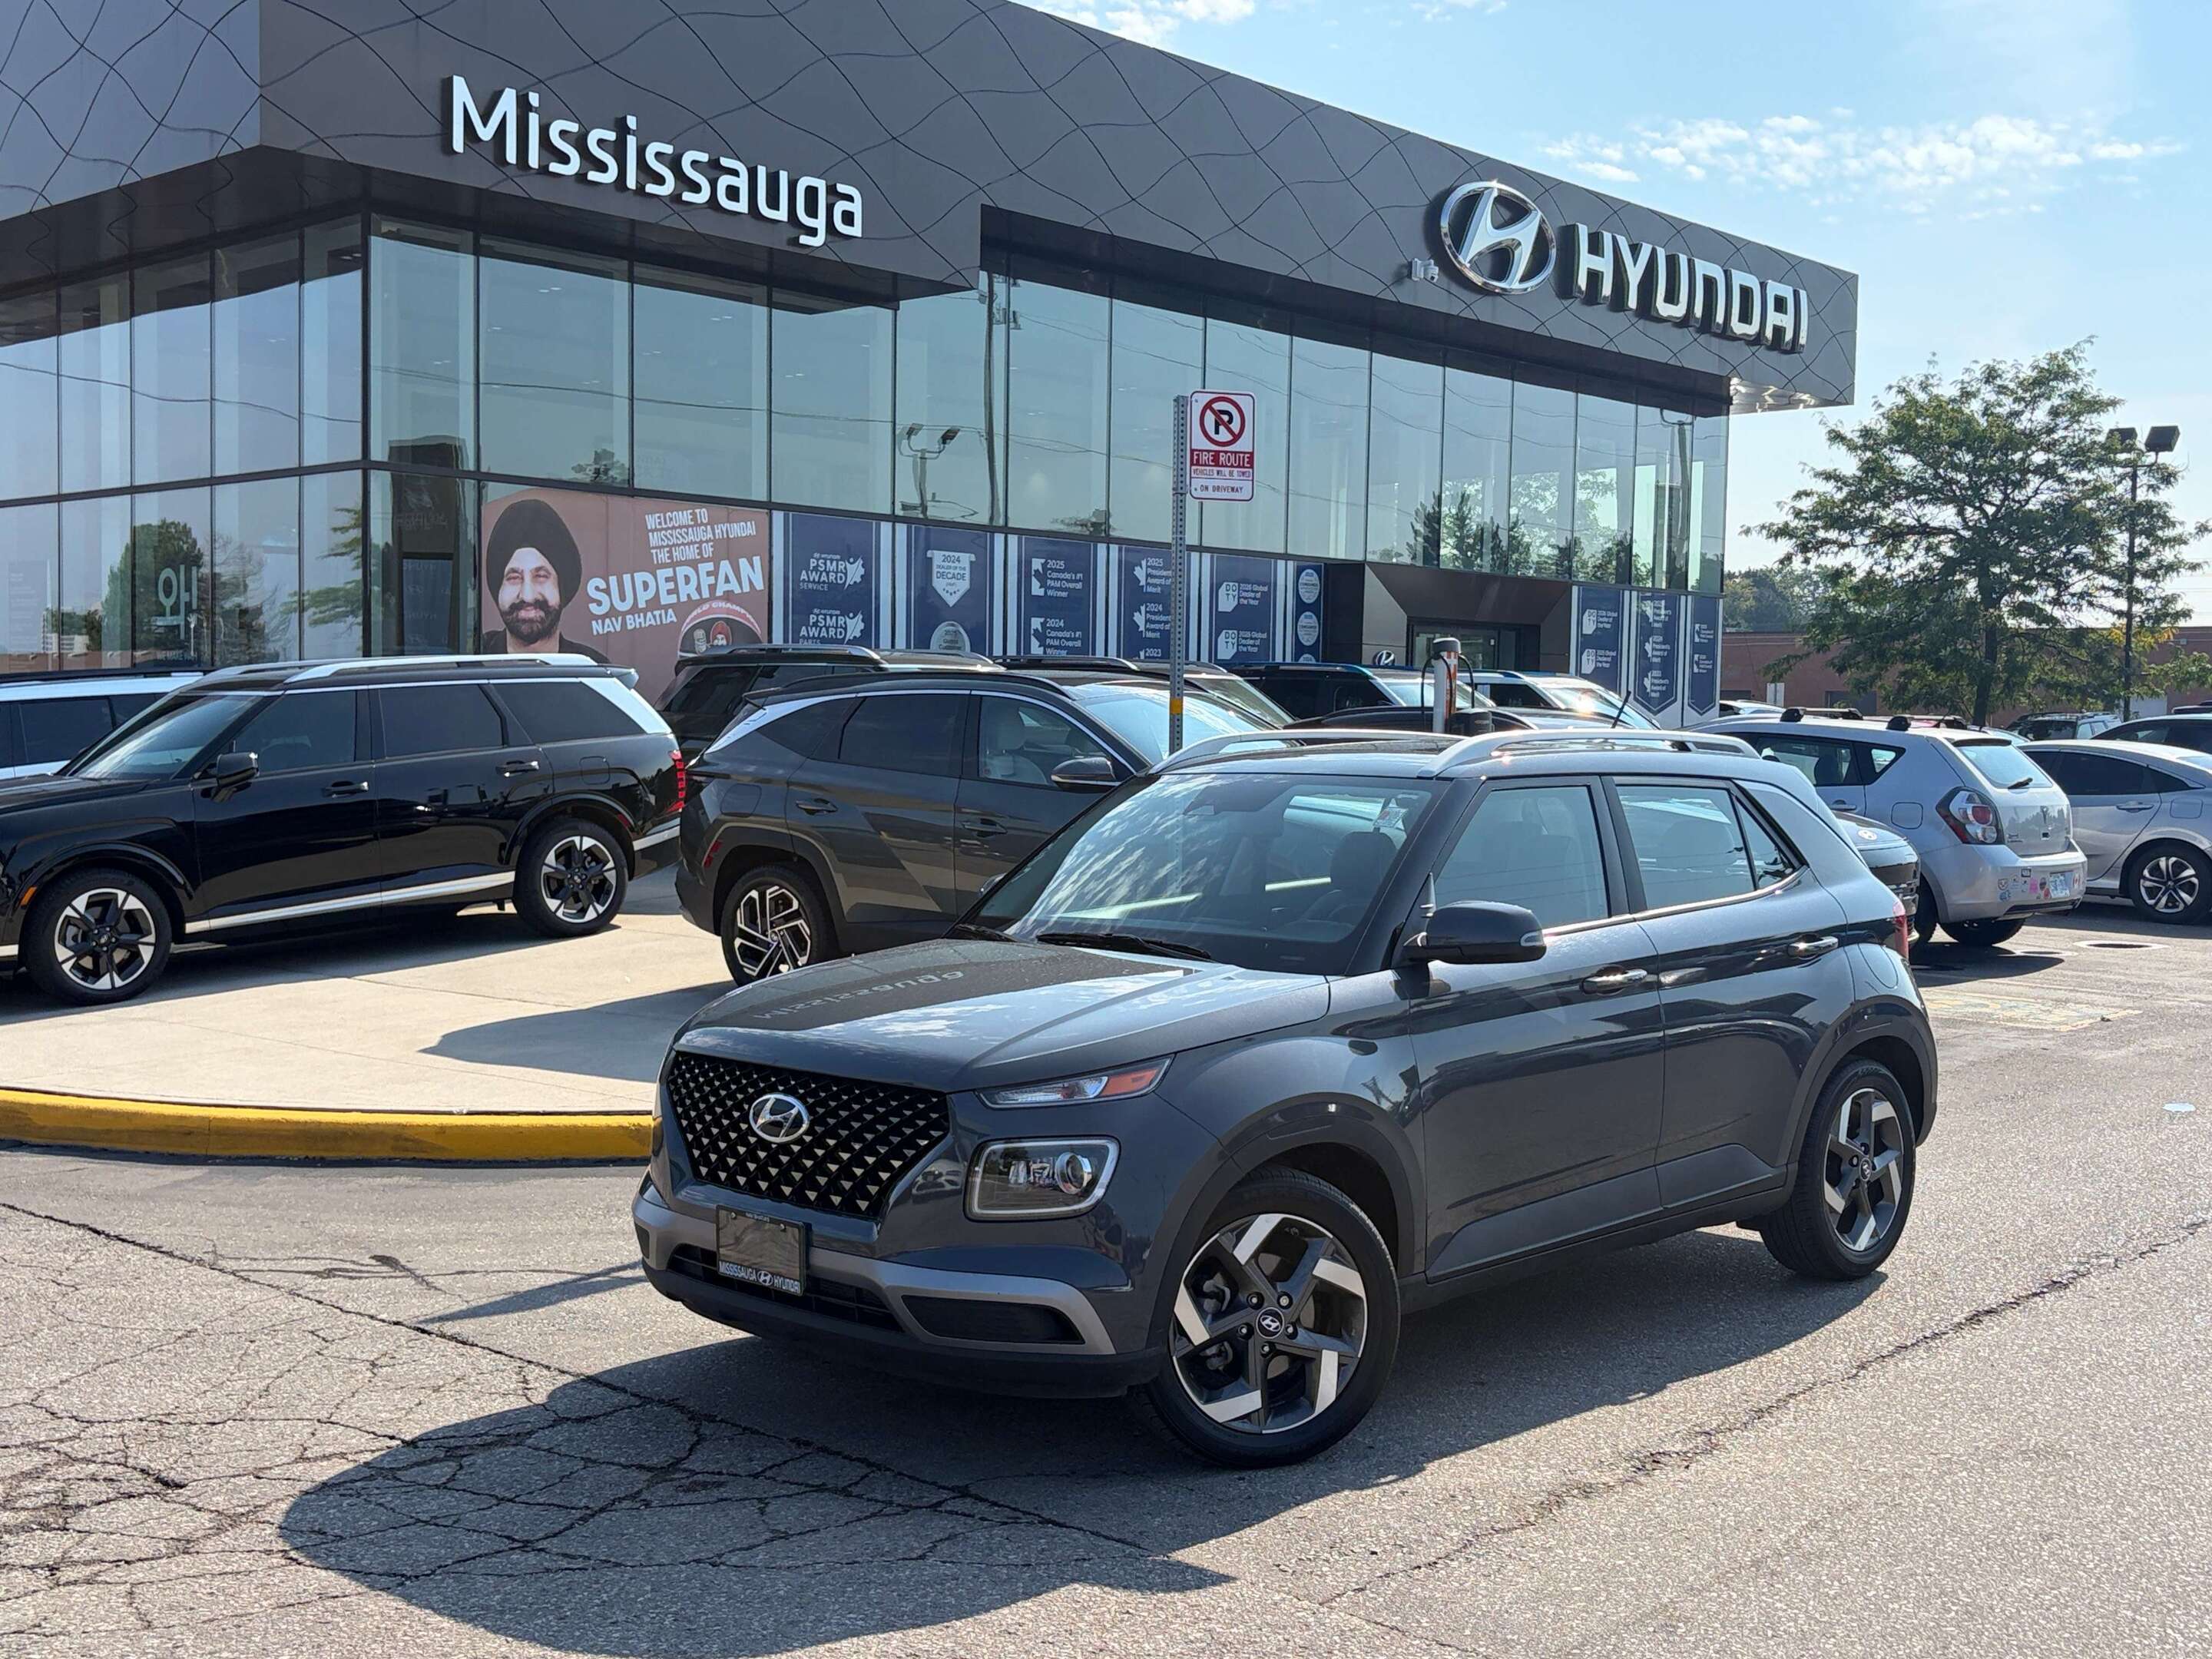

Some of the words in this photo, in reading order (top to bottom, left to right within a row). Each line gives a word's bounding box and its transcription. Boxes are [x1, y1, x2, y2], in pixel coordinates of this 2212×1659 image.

[452, 74, 863, 247] Mississauga
[1571, 222, 1808, 353] HYUNDAI
[1193, 451, 1215, 465] FIRE
[1219, 452, 1250, 467] ROUTE
[1237, 469, 1251, 478] TOWED
[1212, 485, 1243, 493] DRIVEWAY
[645, 509, 694, 530] WELCOME
[694, 508, 709, 524] TO
[648, 525, 714, 548] MISSISSAUGA
[714, 521, 757, 540] HYUNDAI
[651, 548, 672, 565] THE
[672, 545, 700, 562] HOME
[702, 542, 714, 558] OF
[942, 554, 960, 564] 2024
[1047, 559, 1065, 569] 2025
[1147, 558, 1164, 567] 2025
[810, 558, 846, 573] PSMR
[800, 570, 845, 584] AWARD
[936, 571, 966, 581] DECADE
[1047, 571, 1075, 580] Canada's
[587, 555, 764, 616] SUPERFAN
[800, 582, 829, 591] SERVICE
[1047, 579, 1060, 588] PAM
[1061, 581, 1082, 589] Overall
[1047, 589, 1068, 598] Winner
[1147, 585, 1161, 594] Merit
[1146, 602, 1163, 612] 2024
[591, 618, 622, 636] NAV
[626, 608, 677, 631] BHATIA
[810, 614, 846, 628] PSMR
[1046, 618, 1064, 628] 2024
[800, 625, 845, 639] AWARD
[1046, 629, 1075, 638] Canada's
[1061, 638, 1081, 647] Overall
[1046, 647, 1068, 656] Winner
[1145, 648, 1161, 657] 2023
[719, 1260, 757, 1282] MISSISSAUGA
[773, 1275, 801, 1294] HYUNDAI
